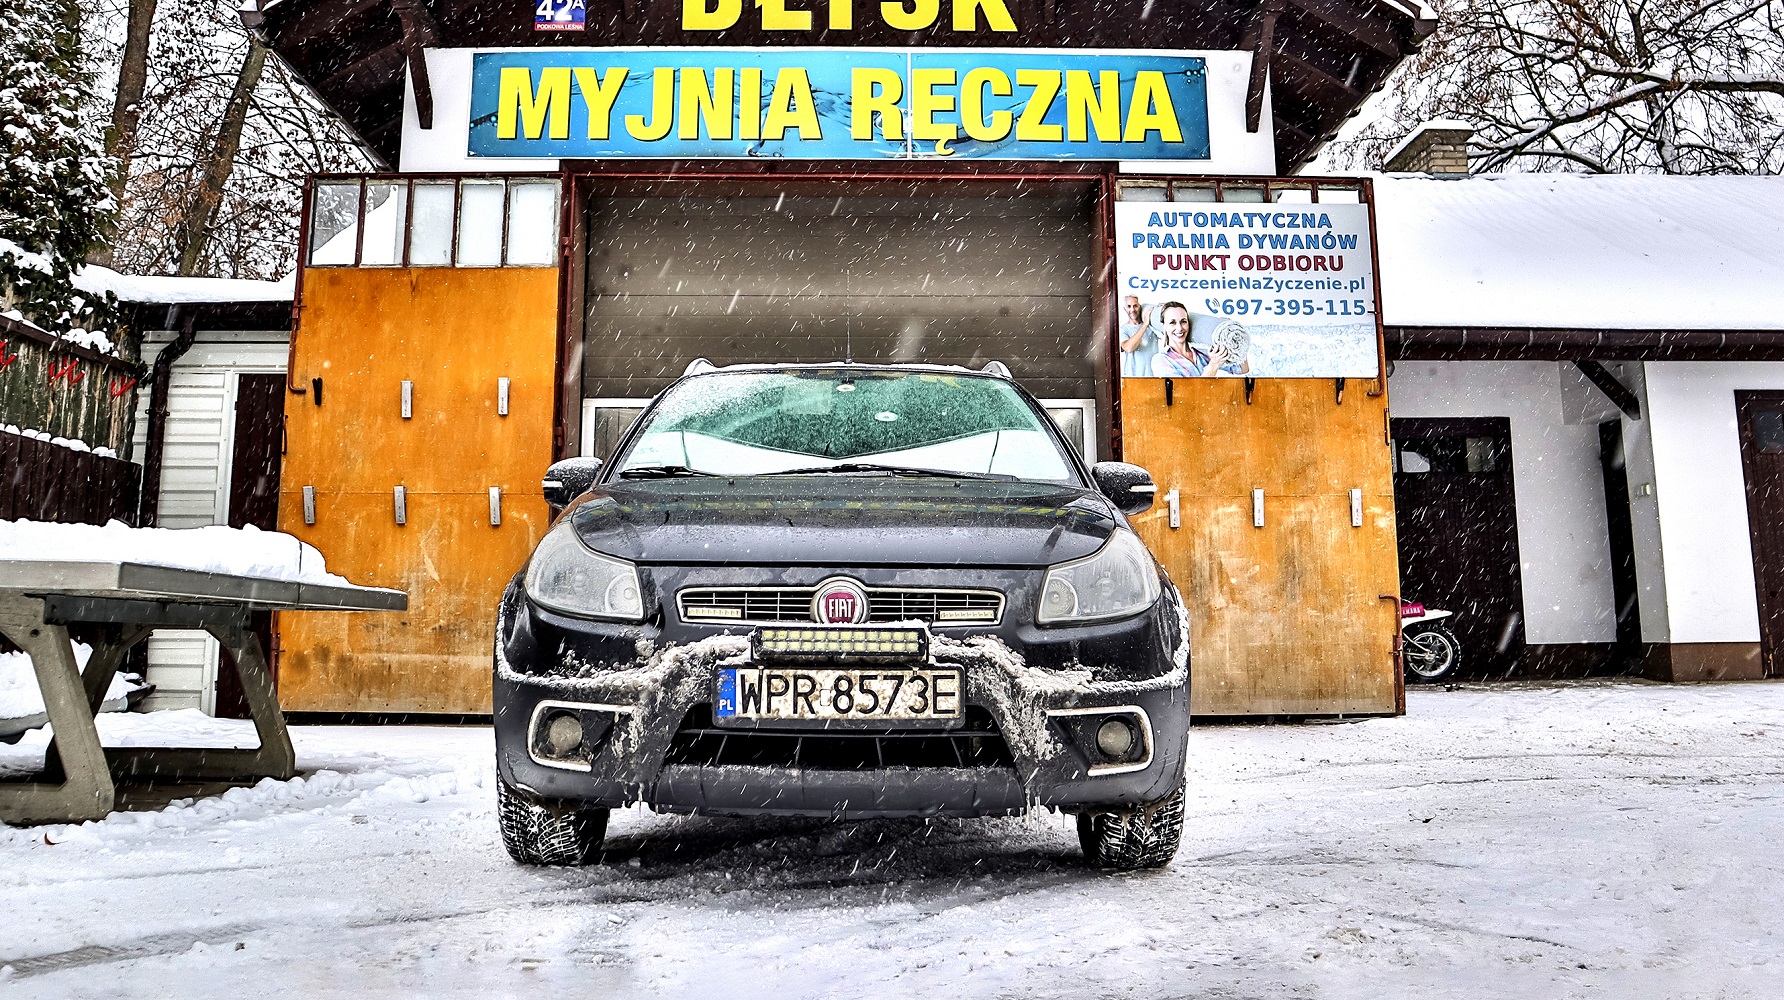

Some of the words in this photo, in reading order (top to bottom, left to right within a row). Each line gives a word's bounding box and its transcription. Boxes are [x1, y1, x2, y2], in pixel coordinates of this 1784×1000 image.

[496, 66, 823, 141] MYJNIA
[850, 67, 1184, 156] RĘCZNA
[1147, 211, 1333, 229] AUTOMATYCZNA
[1132, 232, 1230, 249] PRALNIA
[1238, 231, 1358, 250] DYWANÓW
[1152, 254, 1231, 271] PUNKT
[1238, 254, 1345, 272] ODBIORU
[1128, 275, 1366, 293] CzyszczenieNaZyczenie.pl
[1221, 298, 1366, 316] 697-395-115
[828, 598, 854, 618] FIAT
[718, 699, 735, 711] PL
[740, 674, 817, 714] WPR
[832, 674, 956, 714] 8573E
